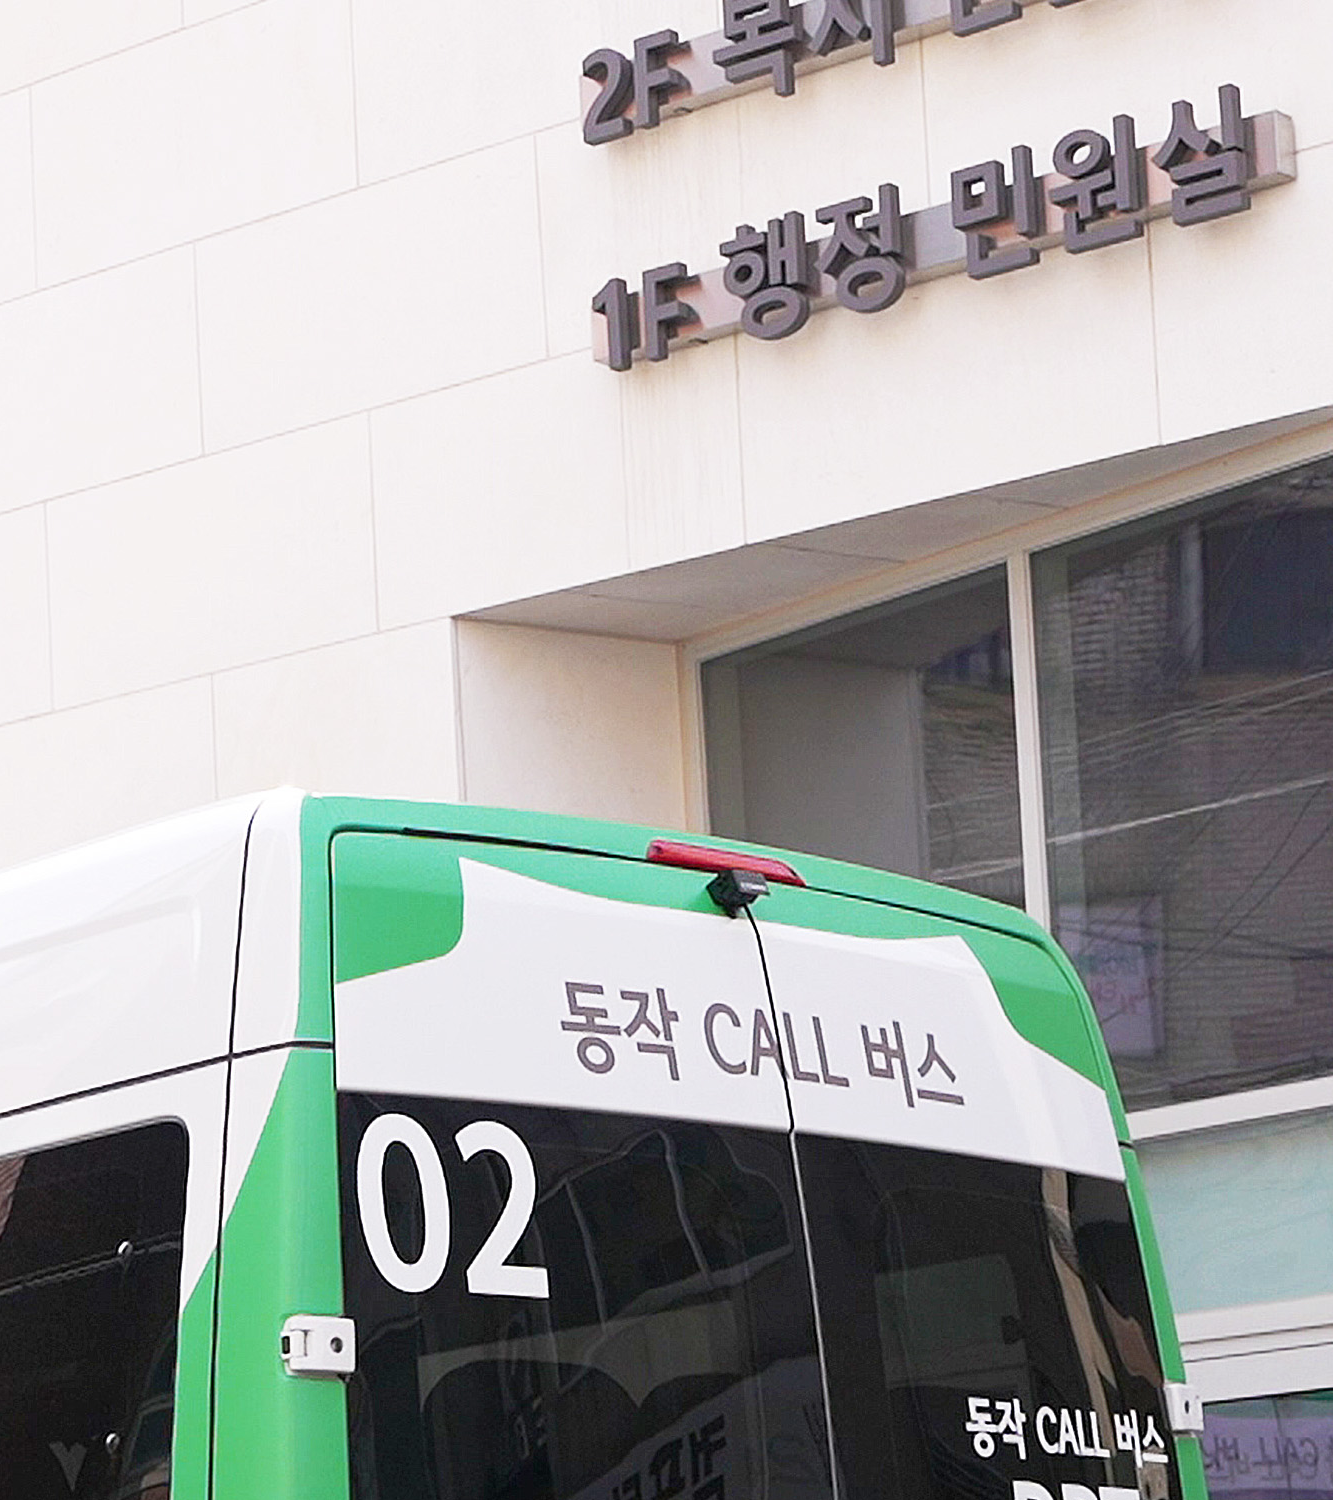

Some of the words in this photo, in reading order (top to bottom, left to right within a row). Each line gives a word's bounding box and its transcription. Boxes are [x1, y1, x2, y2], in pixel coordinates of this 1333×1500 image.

[582, 29, 679, 145] 2F
[592, 261, 689, 371] 1F
[720, 183, 907, 341] 행정
[950, 84, 1252, 279] 민원실
[560, 981, 680, 1081] 동작
[703, 1002, 850, 1087] CALL
[860, 1020, 965, 1108] 버스
[356, 1113, 550, 1299] 02
[965, 1396, 1027, 1460] 동작
[1035, 1405, 1111, 1458] CALL
[1114, 1409, 1169, 1469] 버스
